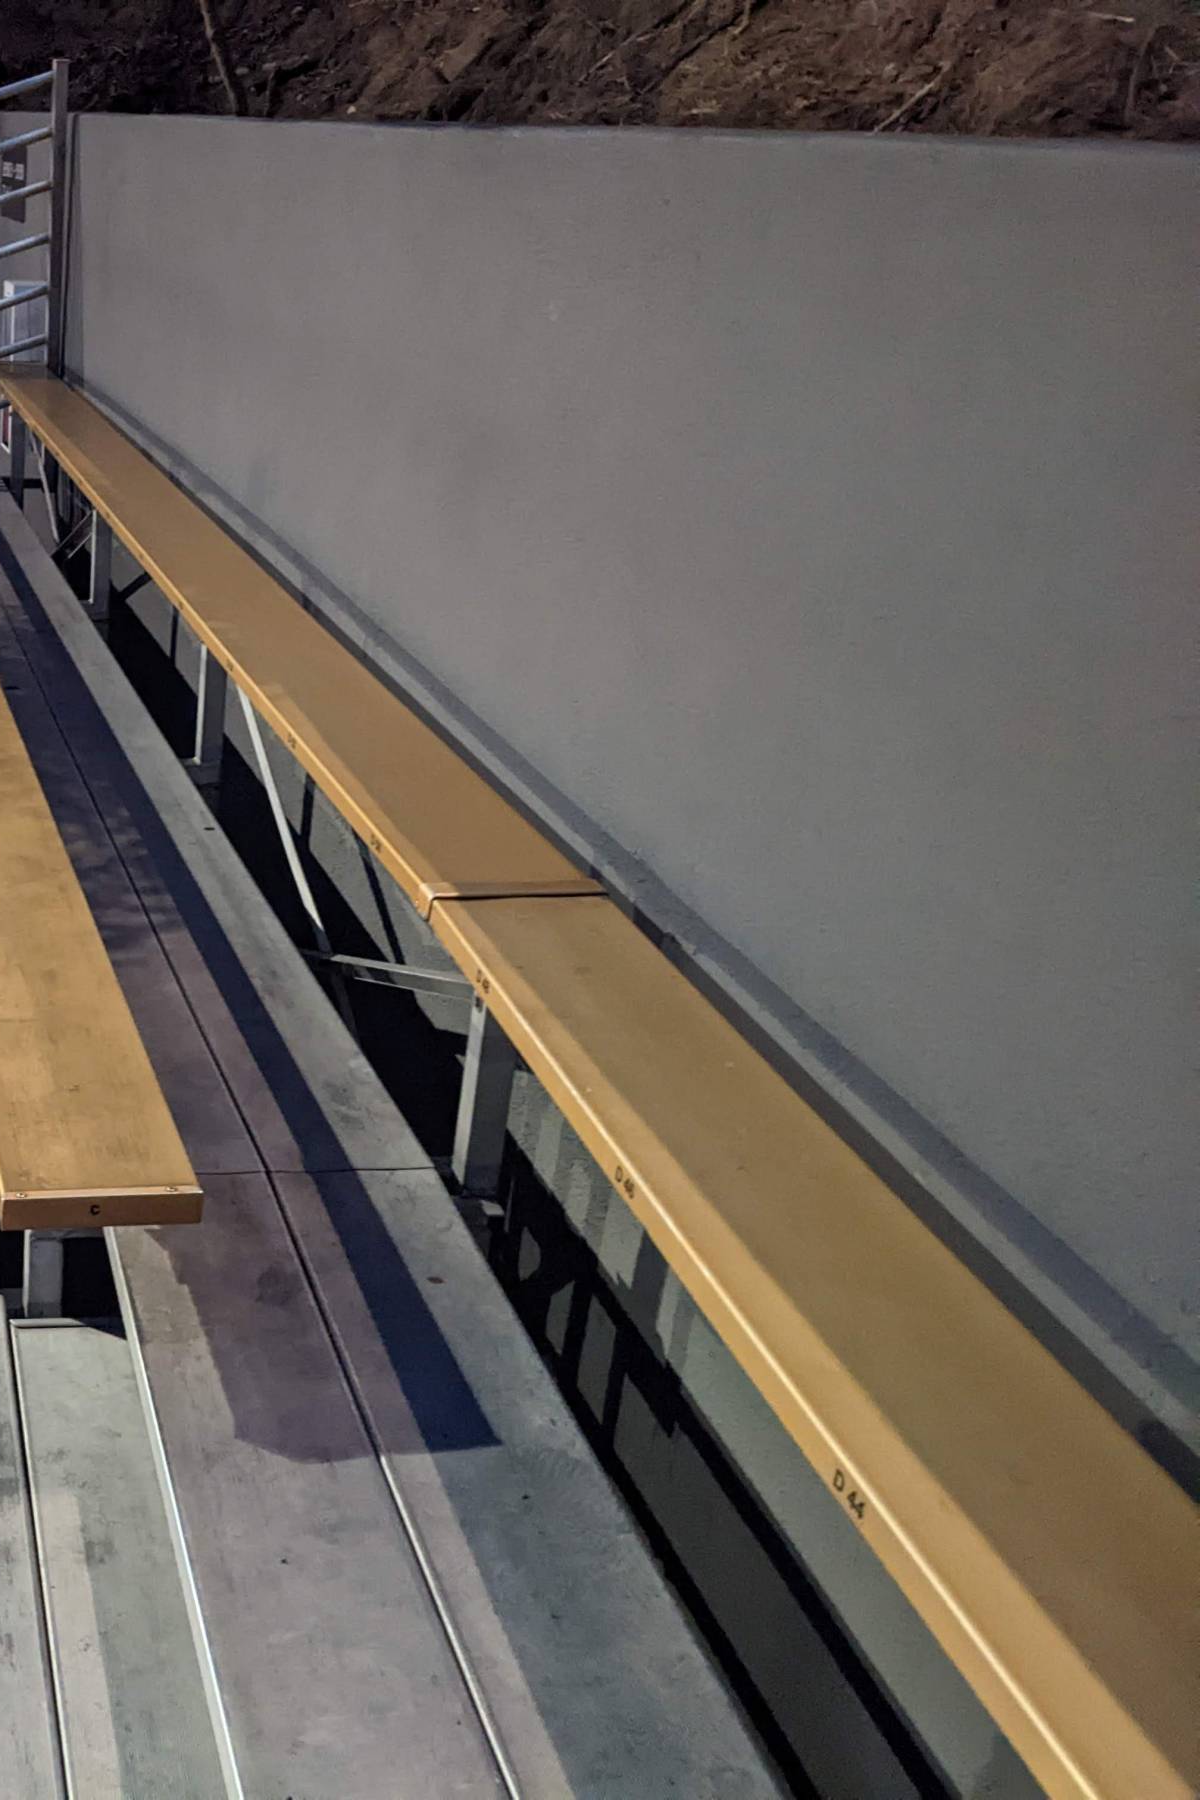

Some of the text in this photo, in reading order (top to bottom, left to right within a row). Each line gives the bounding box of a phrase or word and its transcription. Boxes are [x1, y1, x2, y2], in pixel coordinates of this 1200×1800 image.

[615, 1166, 623, 1183] D
[90, 1204, 101, 1216] C
[833, 1469, 865, 1519] D 44
